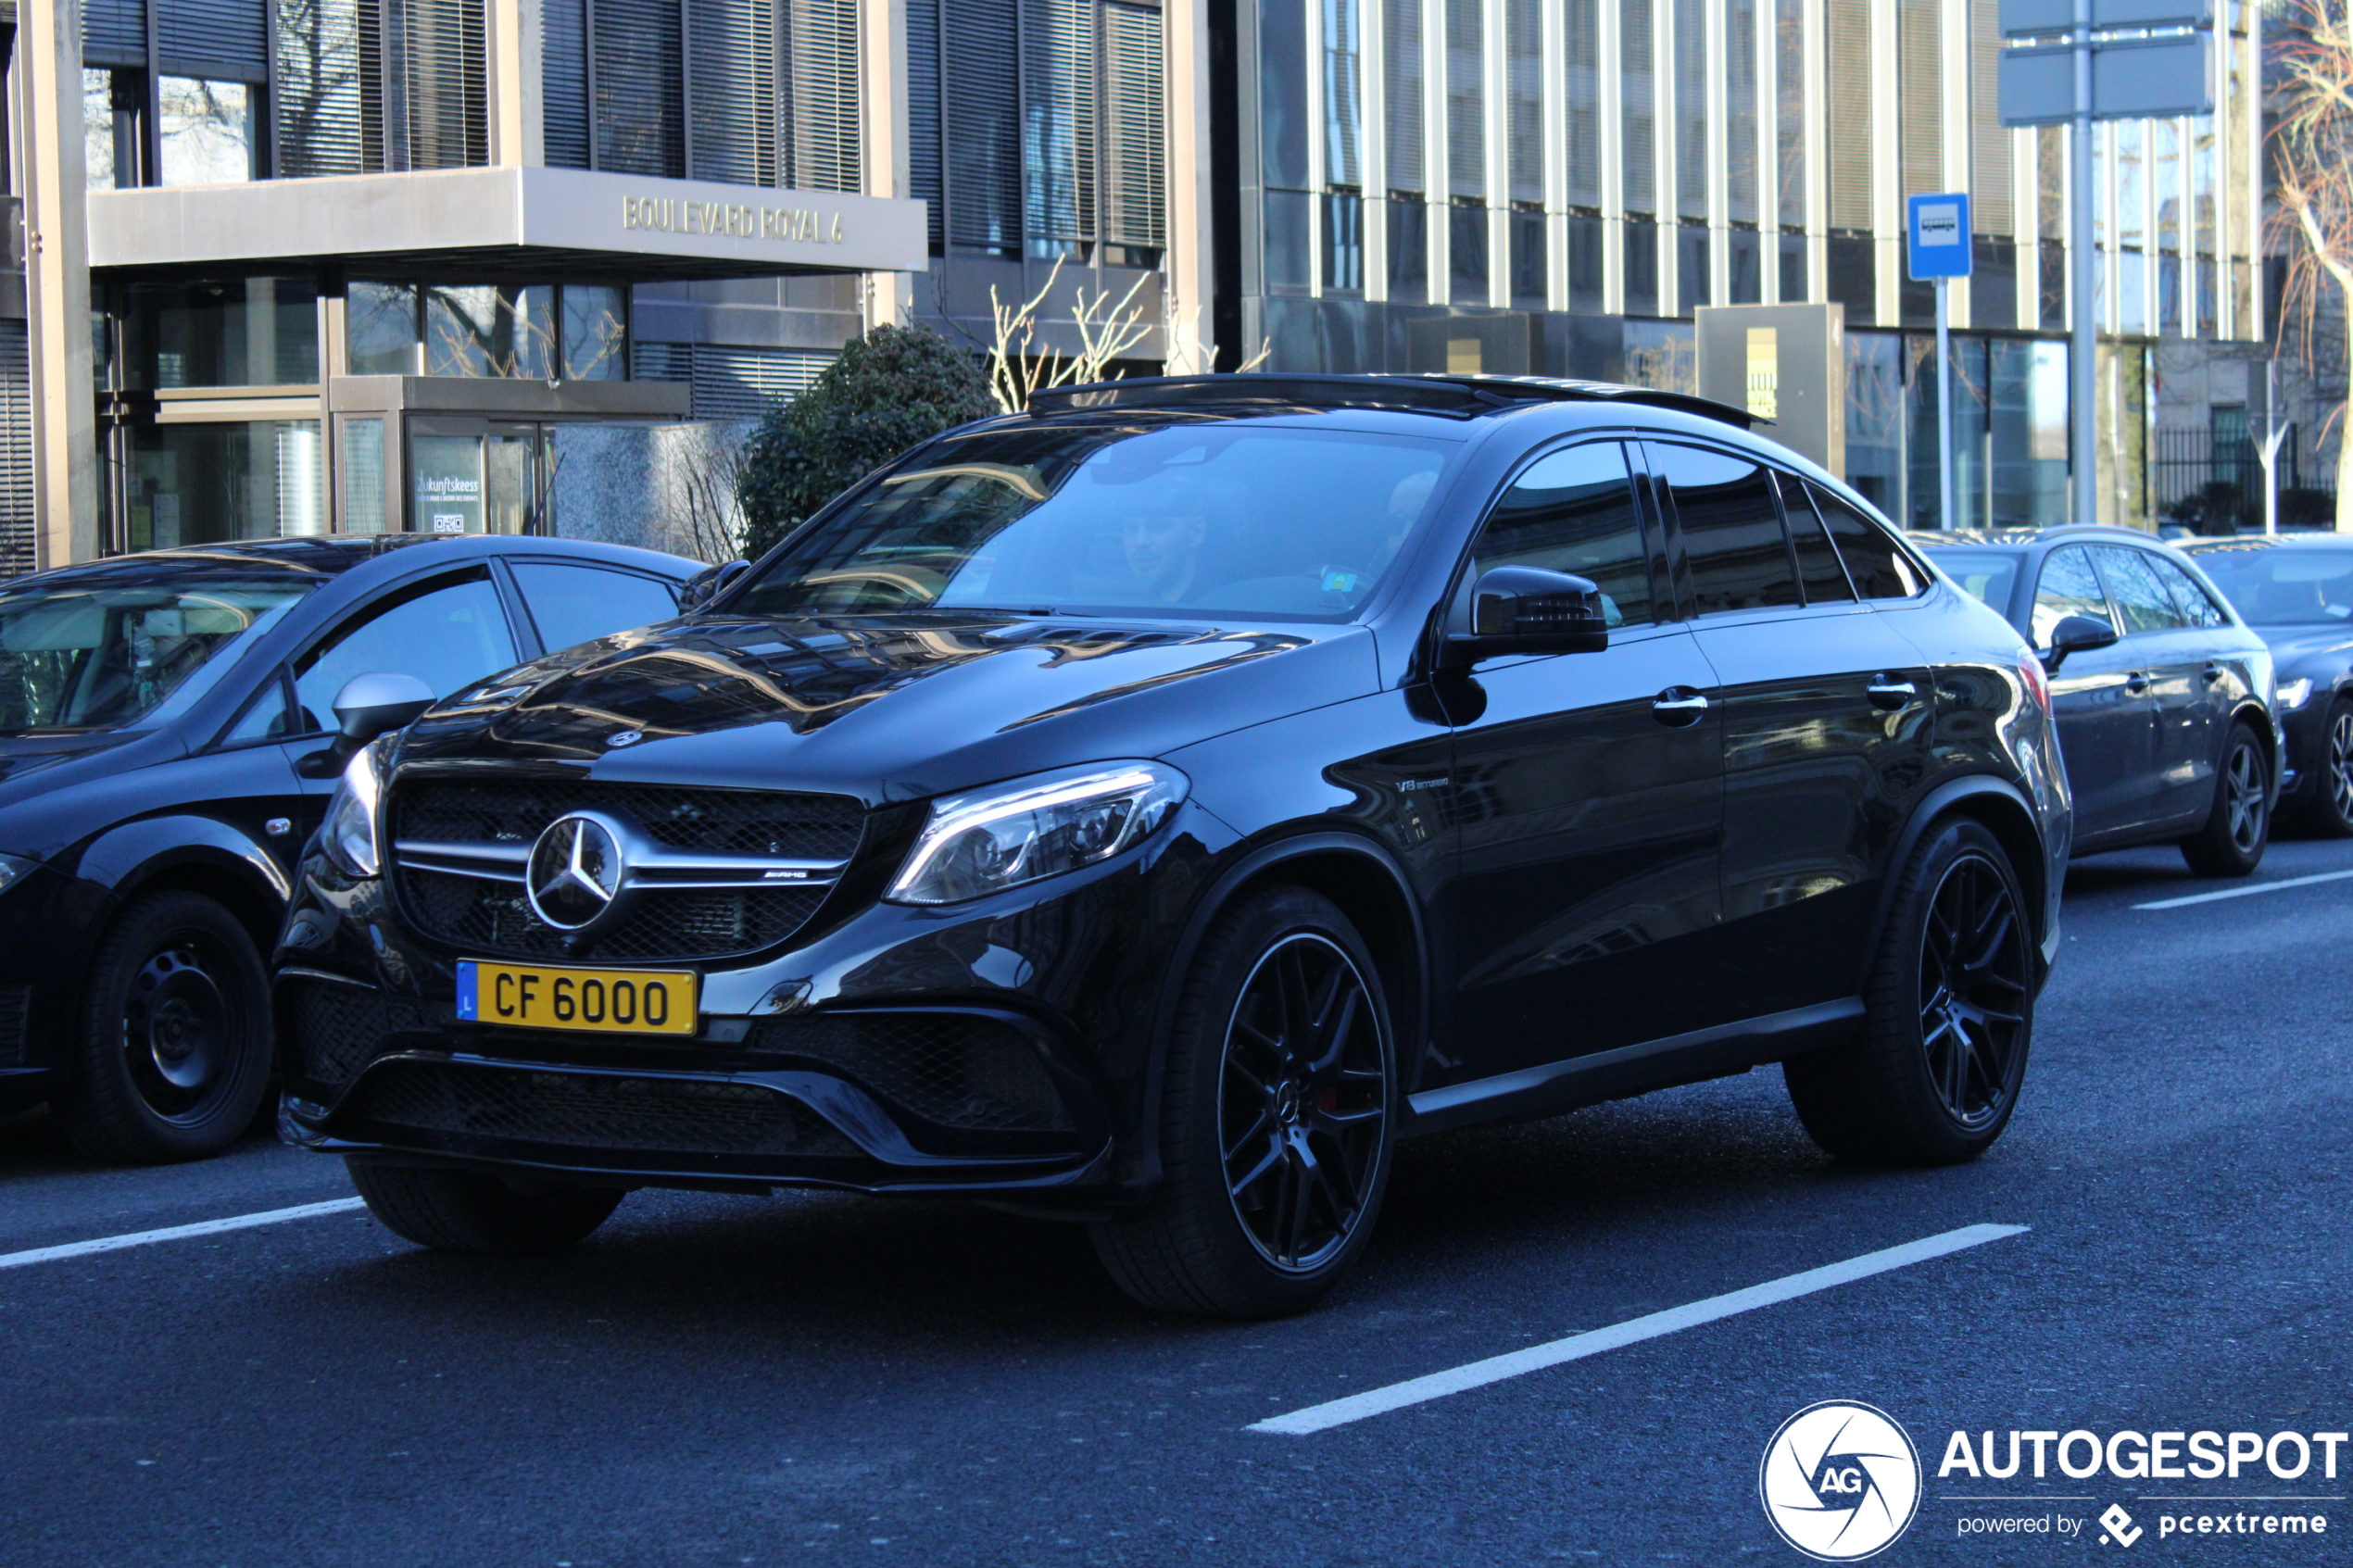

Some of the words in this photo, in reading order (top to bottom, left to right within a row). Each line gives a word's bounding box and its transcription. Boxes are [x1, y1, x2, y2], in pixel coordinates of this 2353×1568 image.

[623, 195, 752, 238] BOULEVARD
[761, 206, 826, 244] ROYAL
[831, 212, 843, 245] 6
[417, 476, 479, 495] Zukunftskeess
[1395, 779, 1416, 793] V8
[1416, 777, 1449, 790] BITURBO
[463, 996, 472, 1011] L
[496, 972, 539, 1018] CF
[553, 976, 668, 1026] 6000
